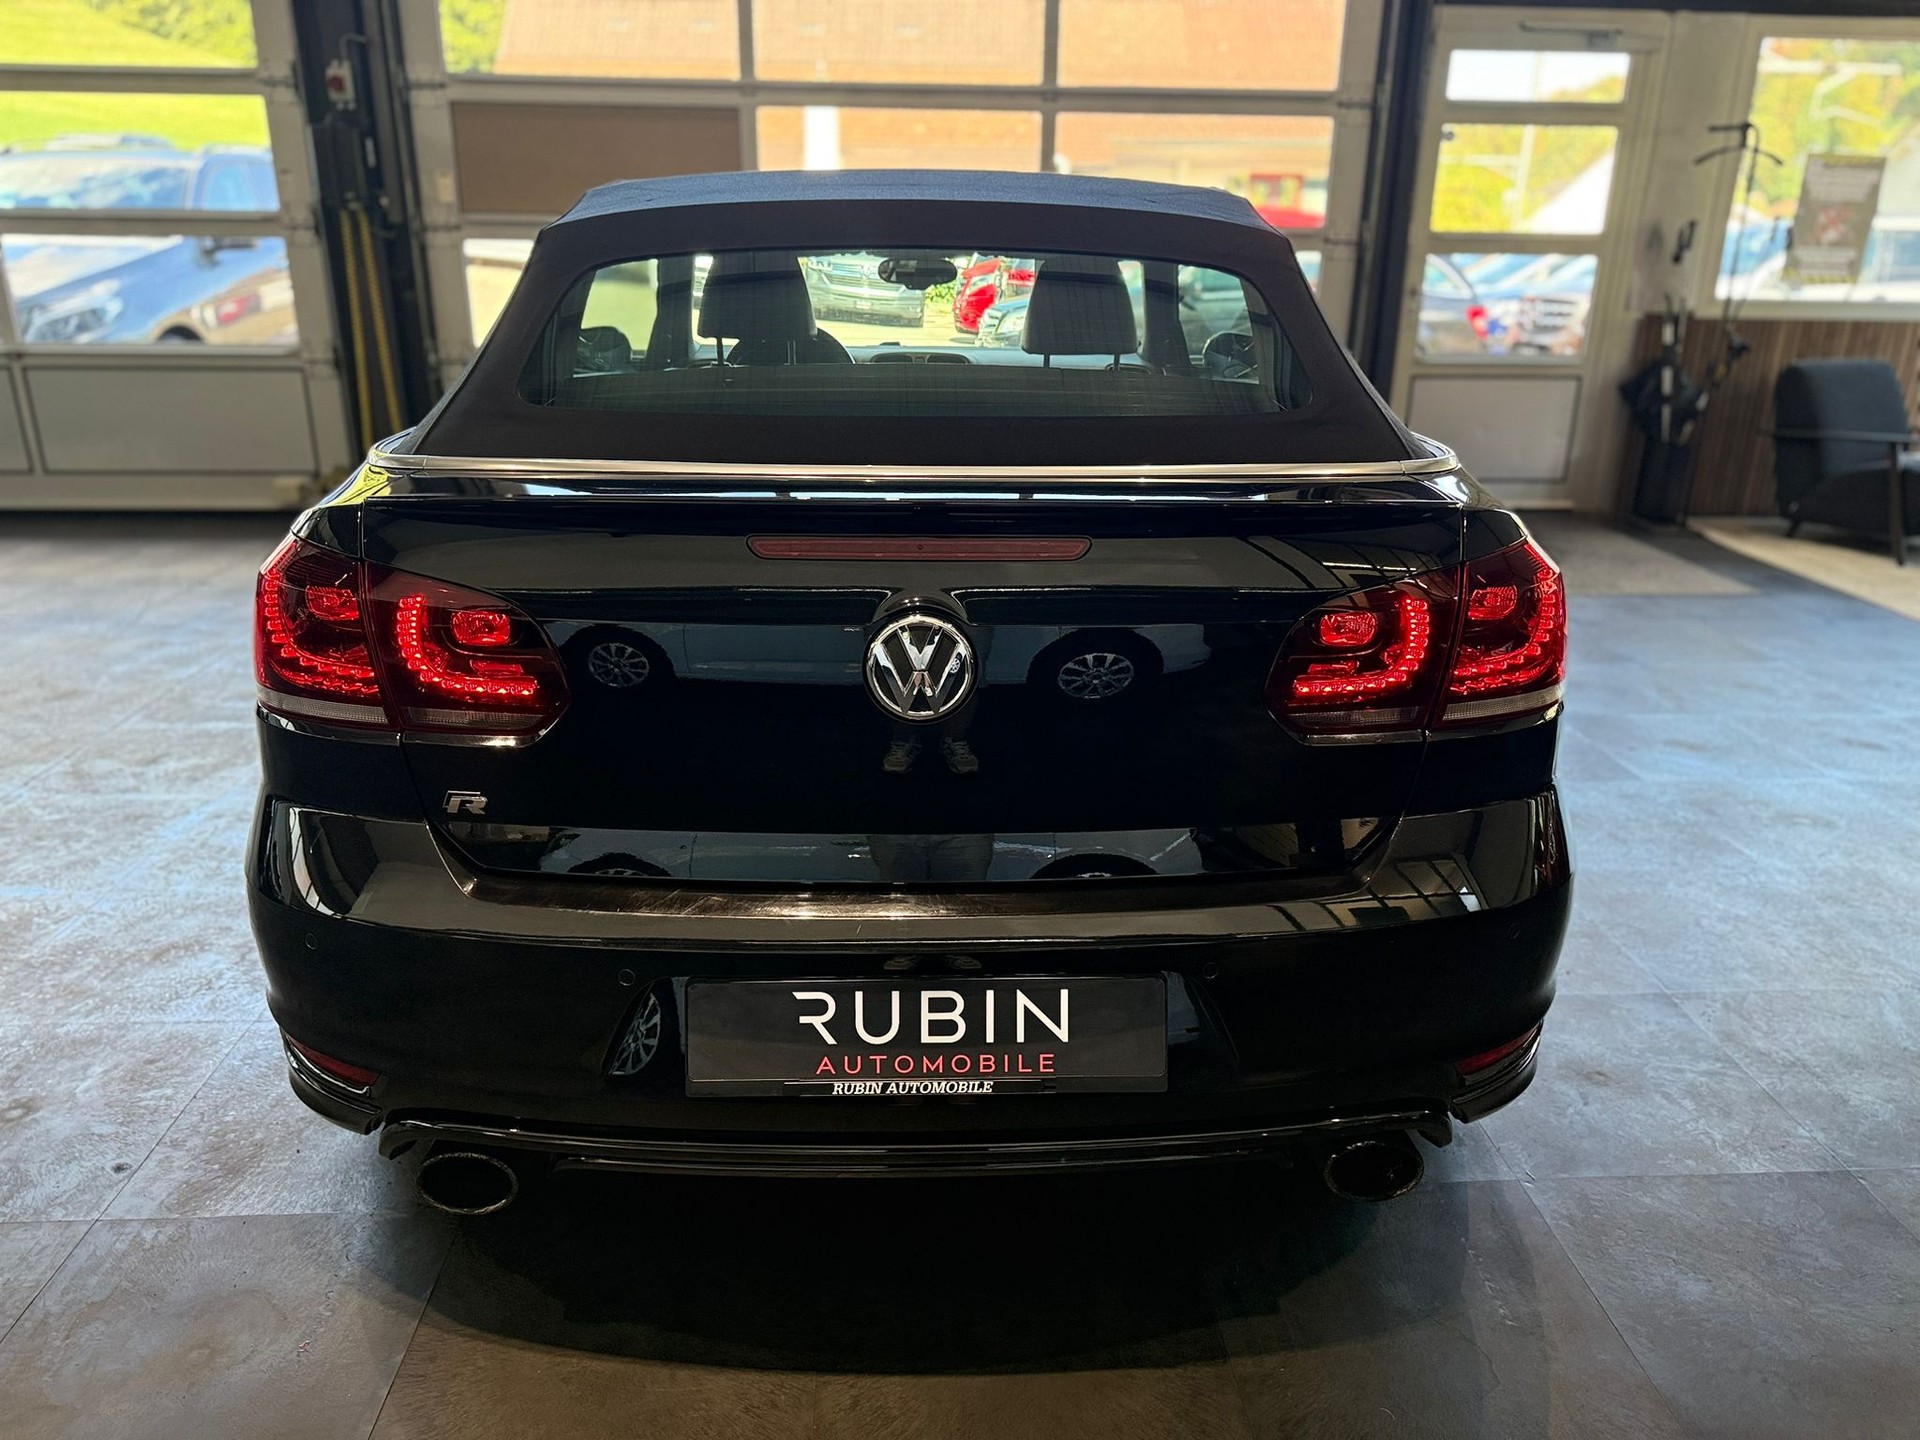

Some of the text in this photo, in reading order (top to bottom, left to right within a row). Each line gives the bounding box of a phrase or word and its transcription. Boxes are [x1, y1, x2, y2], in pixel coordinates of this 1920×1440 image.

[868, 616, 974, 719] VW
[442, 790, 488, 815] R
[791, 988, 1069, 1045] RUBIN
[815, 1053, 1056, 1076] AUTOMOBILE
[832, 1081, 994, 1095] RUBIN AUTOMOBILE
